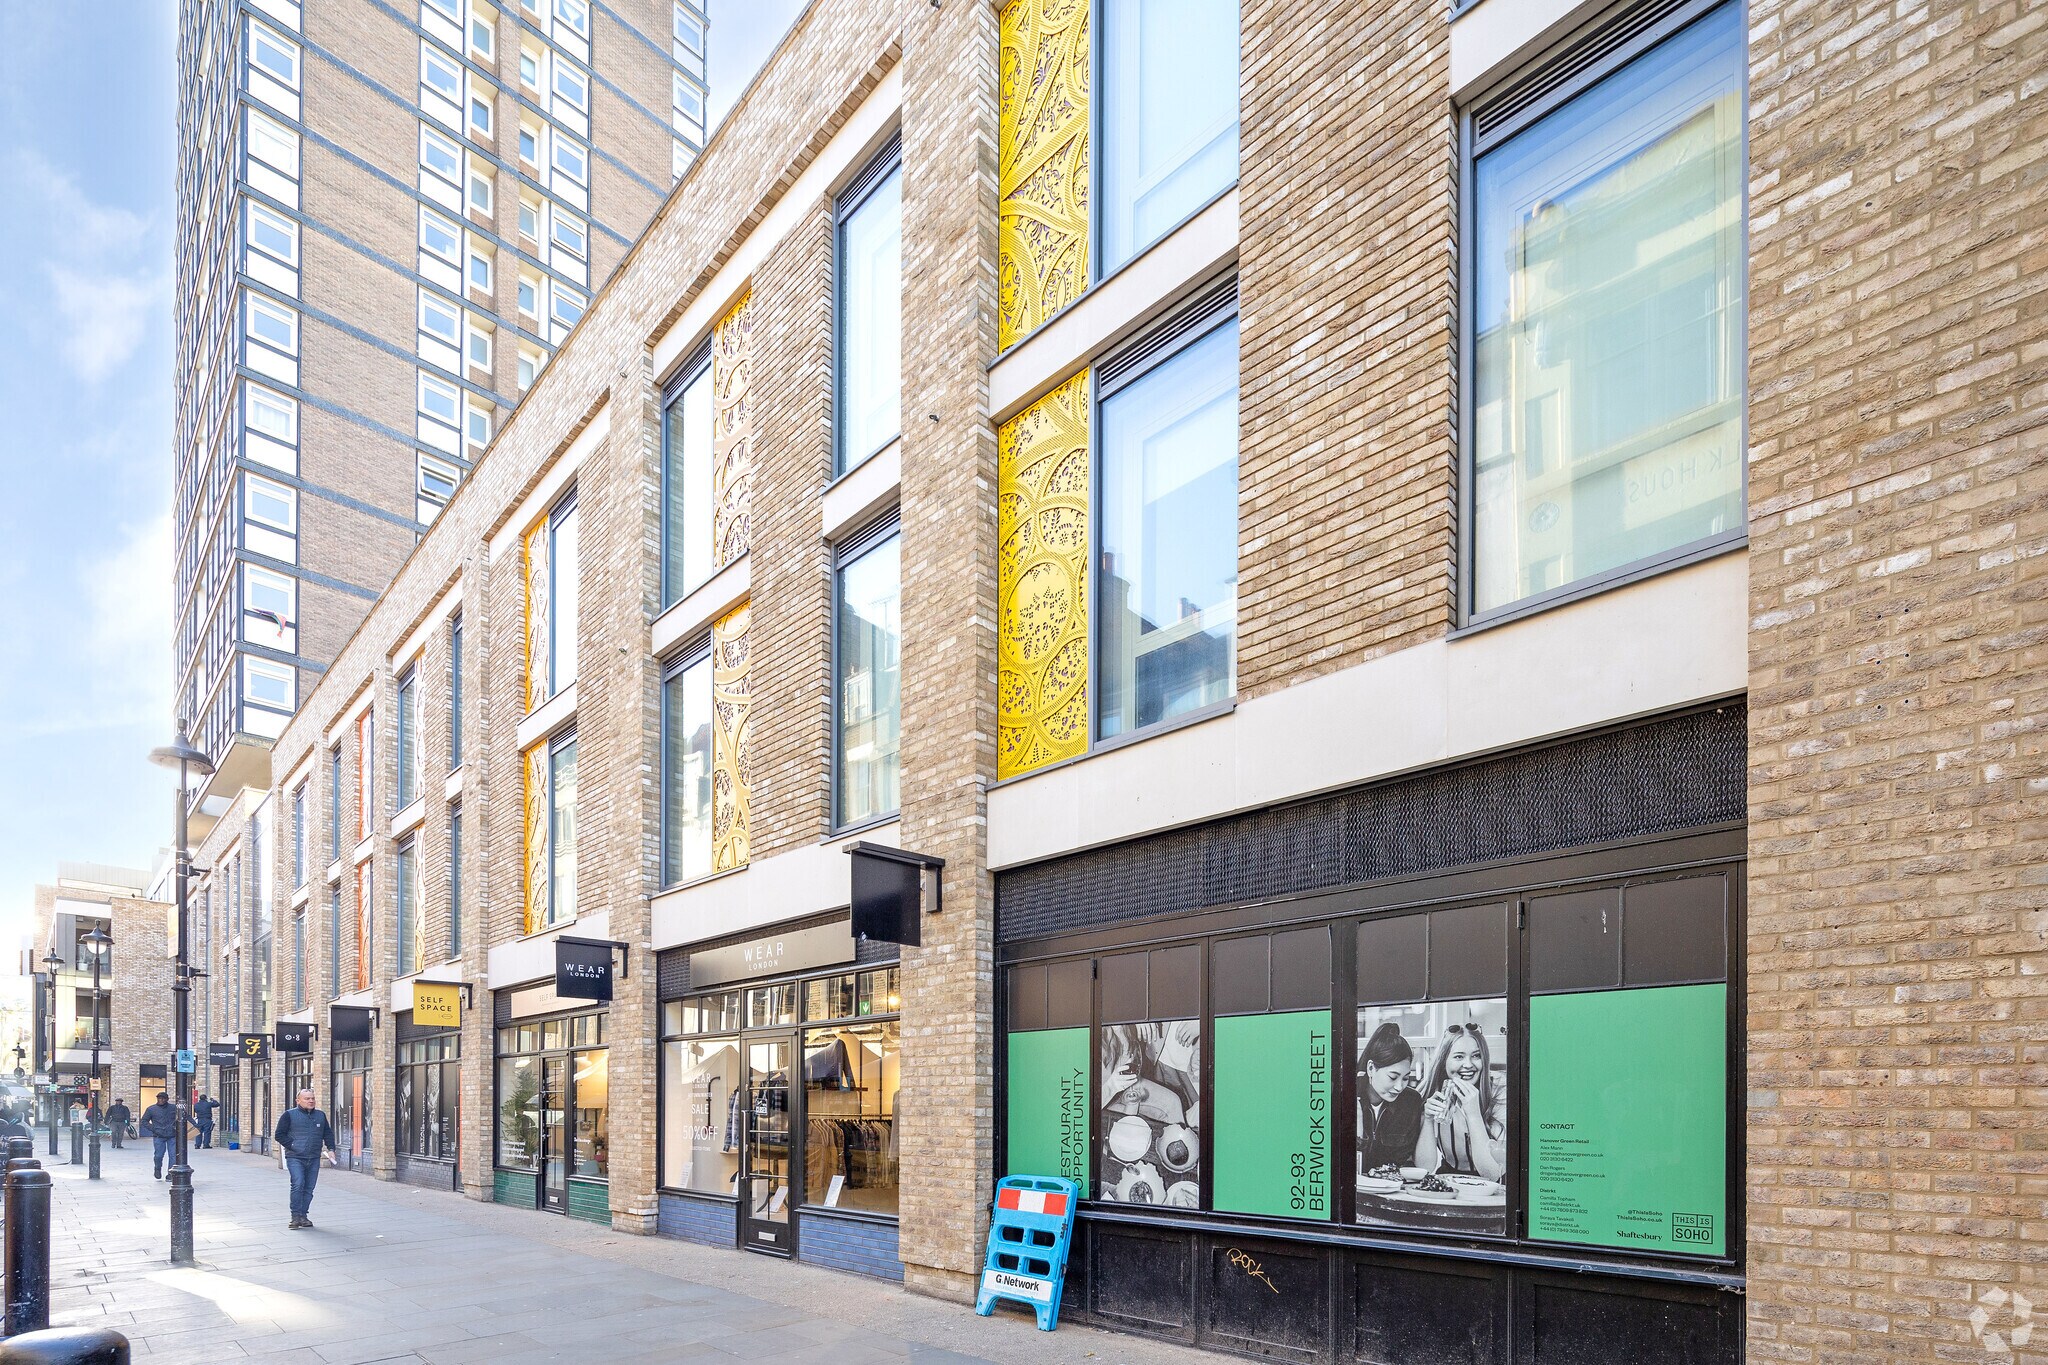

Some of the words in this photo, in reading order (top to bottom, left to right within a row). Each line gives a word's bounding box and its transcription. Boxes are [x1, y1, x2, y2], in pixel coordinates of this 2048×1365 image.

[744, 942, 783, 962] WEAR
[565, 963, 605, 974] WEAR
[749, 959, 779, 971] LONDON
[420, 1004, 452, 1012] SPACE
[1310, 1030, 1326, 1111] STREET
[691, 1103, 709, 1114] SALE
[1060, 1076, 1071, 1179] ESTAURANT
[1073, 1067, 1084, 1191] OPPORTUNITY
[1309, 1116, 1325, 1211] BERWICK
[1290, 1153, 1306, 1210] 92-93
[1617, 1215, 1663, 1223] ThisIsSoho.co.uk
[1675, 1216, 1695, 1224] THIS
[1617, 1230, 1663, 1241] Shaftesbury
[1675, 1228, 1710, 1240] SOHO
